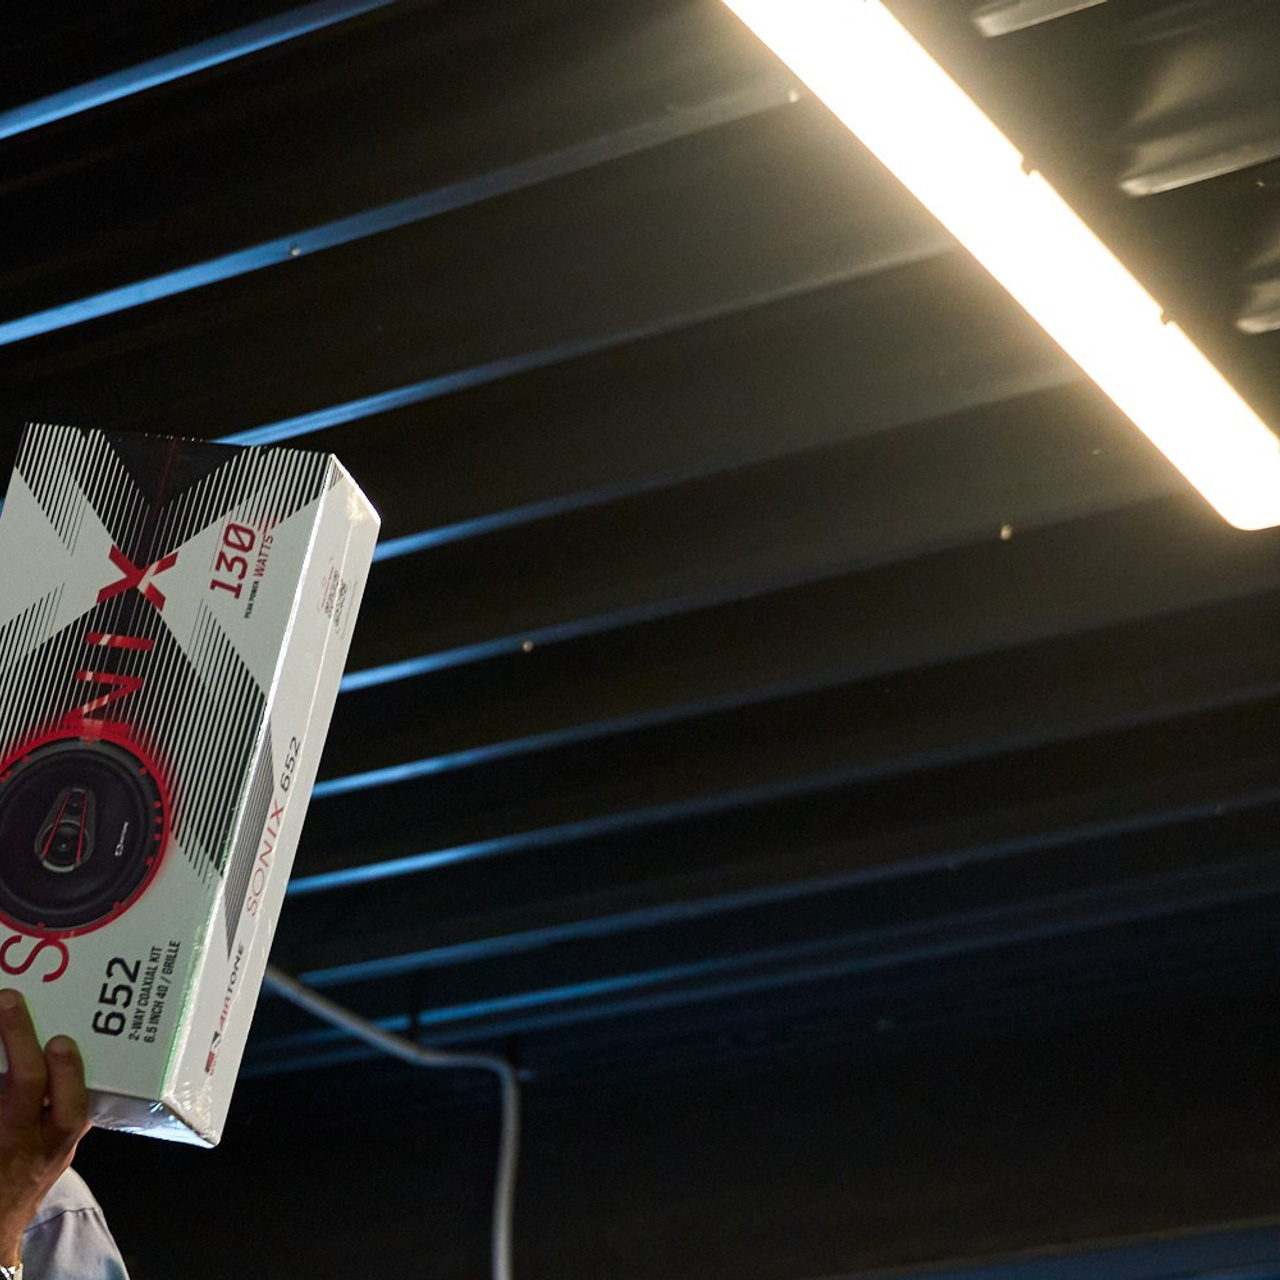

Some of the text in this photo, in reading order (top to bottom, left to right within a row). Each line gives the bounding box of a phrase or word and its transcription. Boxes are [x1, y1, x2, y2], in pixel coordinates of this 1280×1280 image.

[210, 523, 256, 599] 130
[254, 534, 273, 577] WATTS
[246, 736, 301, 917] SONIX 652
[128, 946, 162, 1040] 2-WAY COAXIAL KIT
[161, 940, 180, 975] GRILLE
[220, 942, 244, 1031] AIRTONE
[92, 957, 141, 1036] 652
[143, 1026, 157, 1043] 6.5
[148, 1000, 164, 1025] INCH
